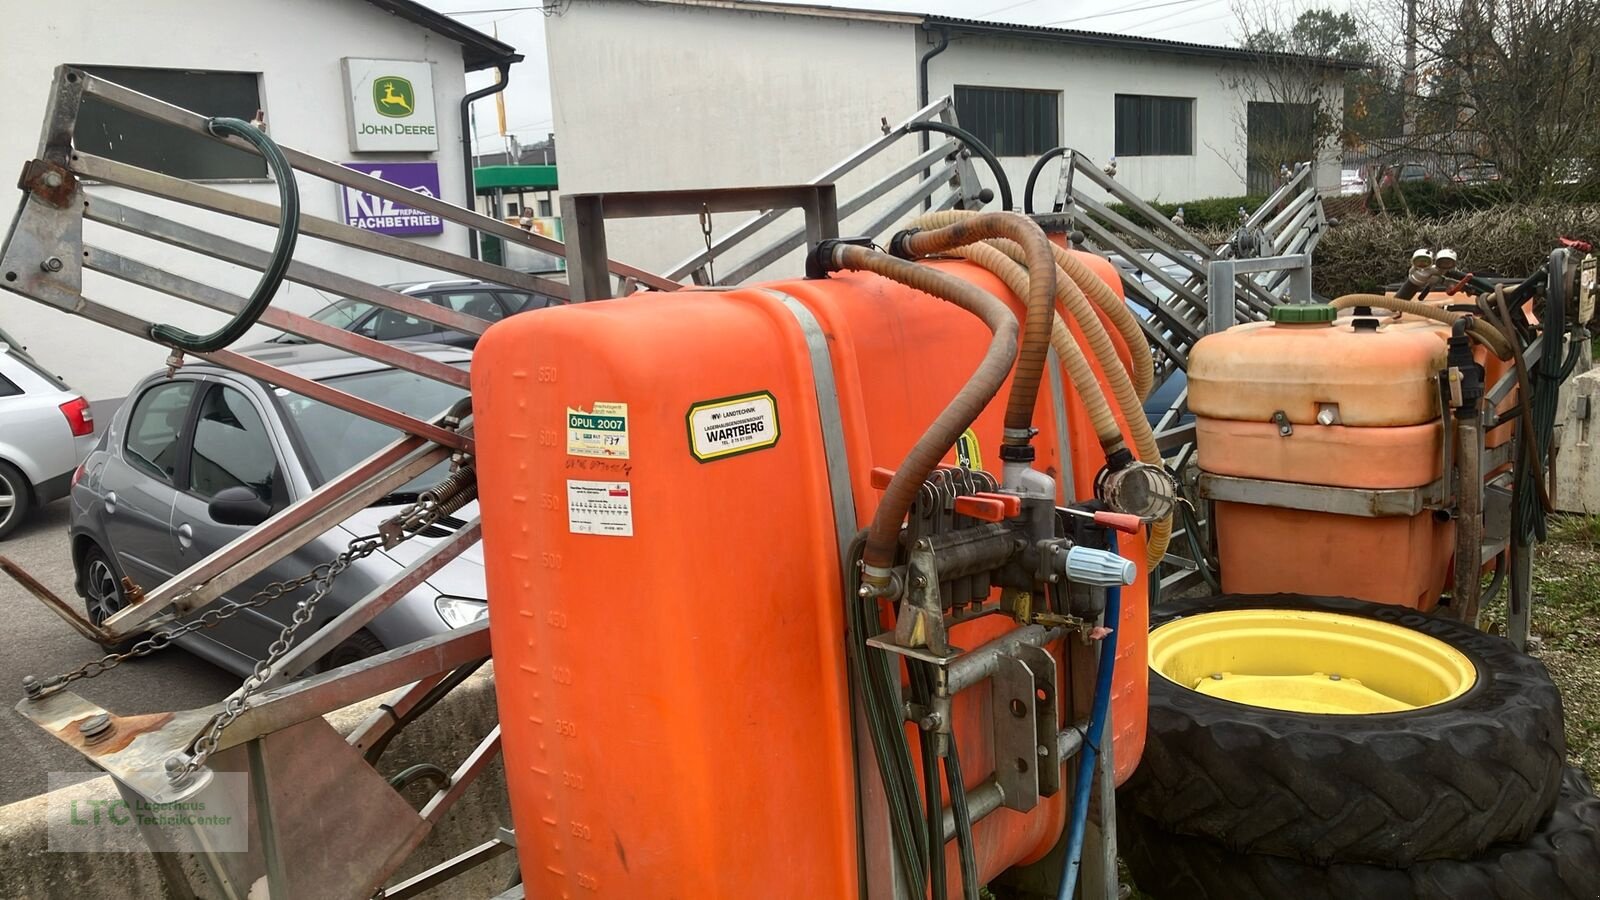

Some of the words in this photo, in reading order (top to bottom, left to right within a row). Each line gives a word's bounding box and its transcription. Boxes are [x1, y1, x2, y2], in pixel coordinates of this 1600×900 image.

[358, 123, 393, 135] JOHN
[395, 123, 436, 135] DEERE
[350, 215, 440, 229] FACHBETRIEB
[570, 416, 595, 429] ÖPUL
[597, 419, 623, 430] 2007
[706, 421, 764, 443] WARTBERG
